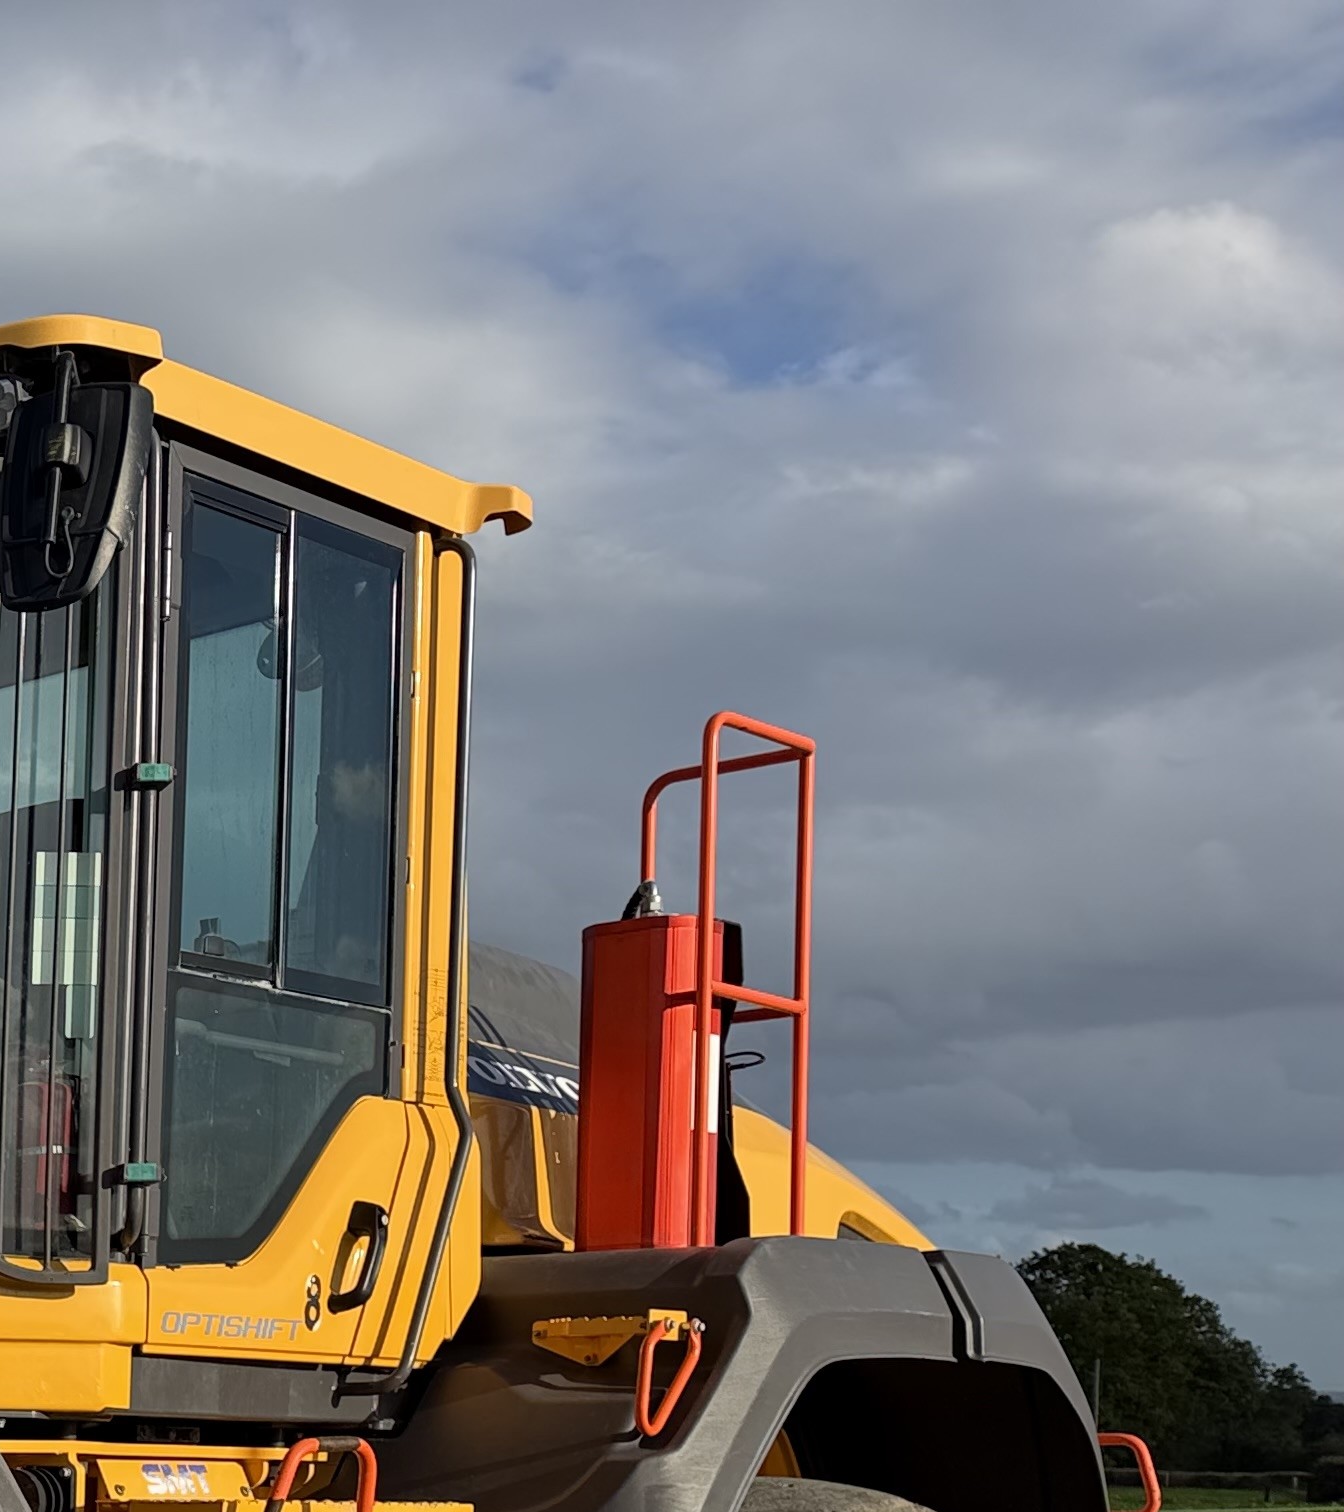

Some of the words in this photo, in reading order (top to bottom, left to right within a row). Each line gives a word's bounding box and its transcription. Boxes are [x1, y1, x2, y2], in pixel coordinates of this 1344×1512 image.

[467, 1056, 579, 1100] OLVO
[160, 1311, 303, 1341] OPTISHIFT
[141, 1464, 210, 1495] SMT
